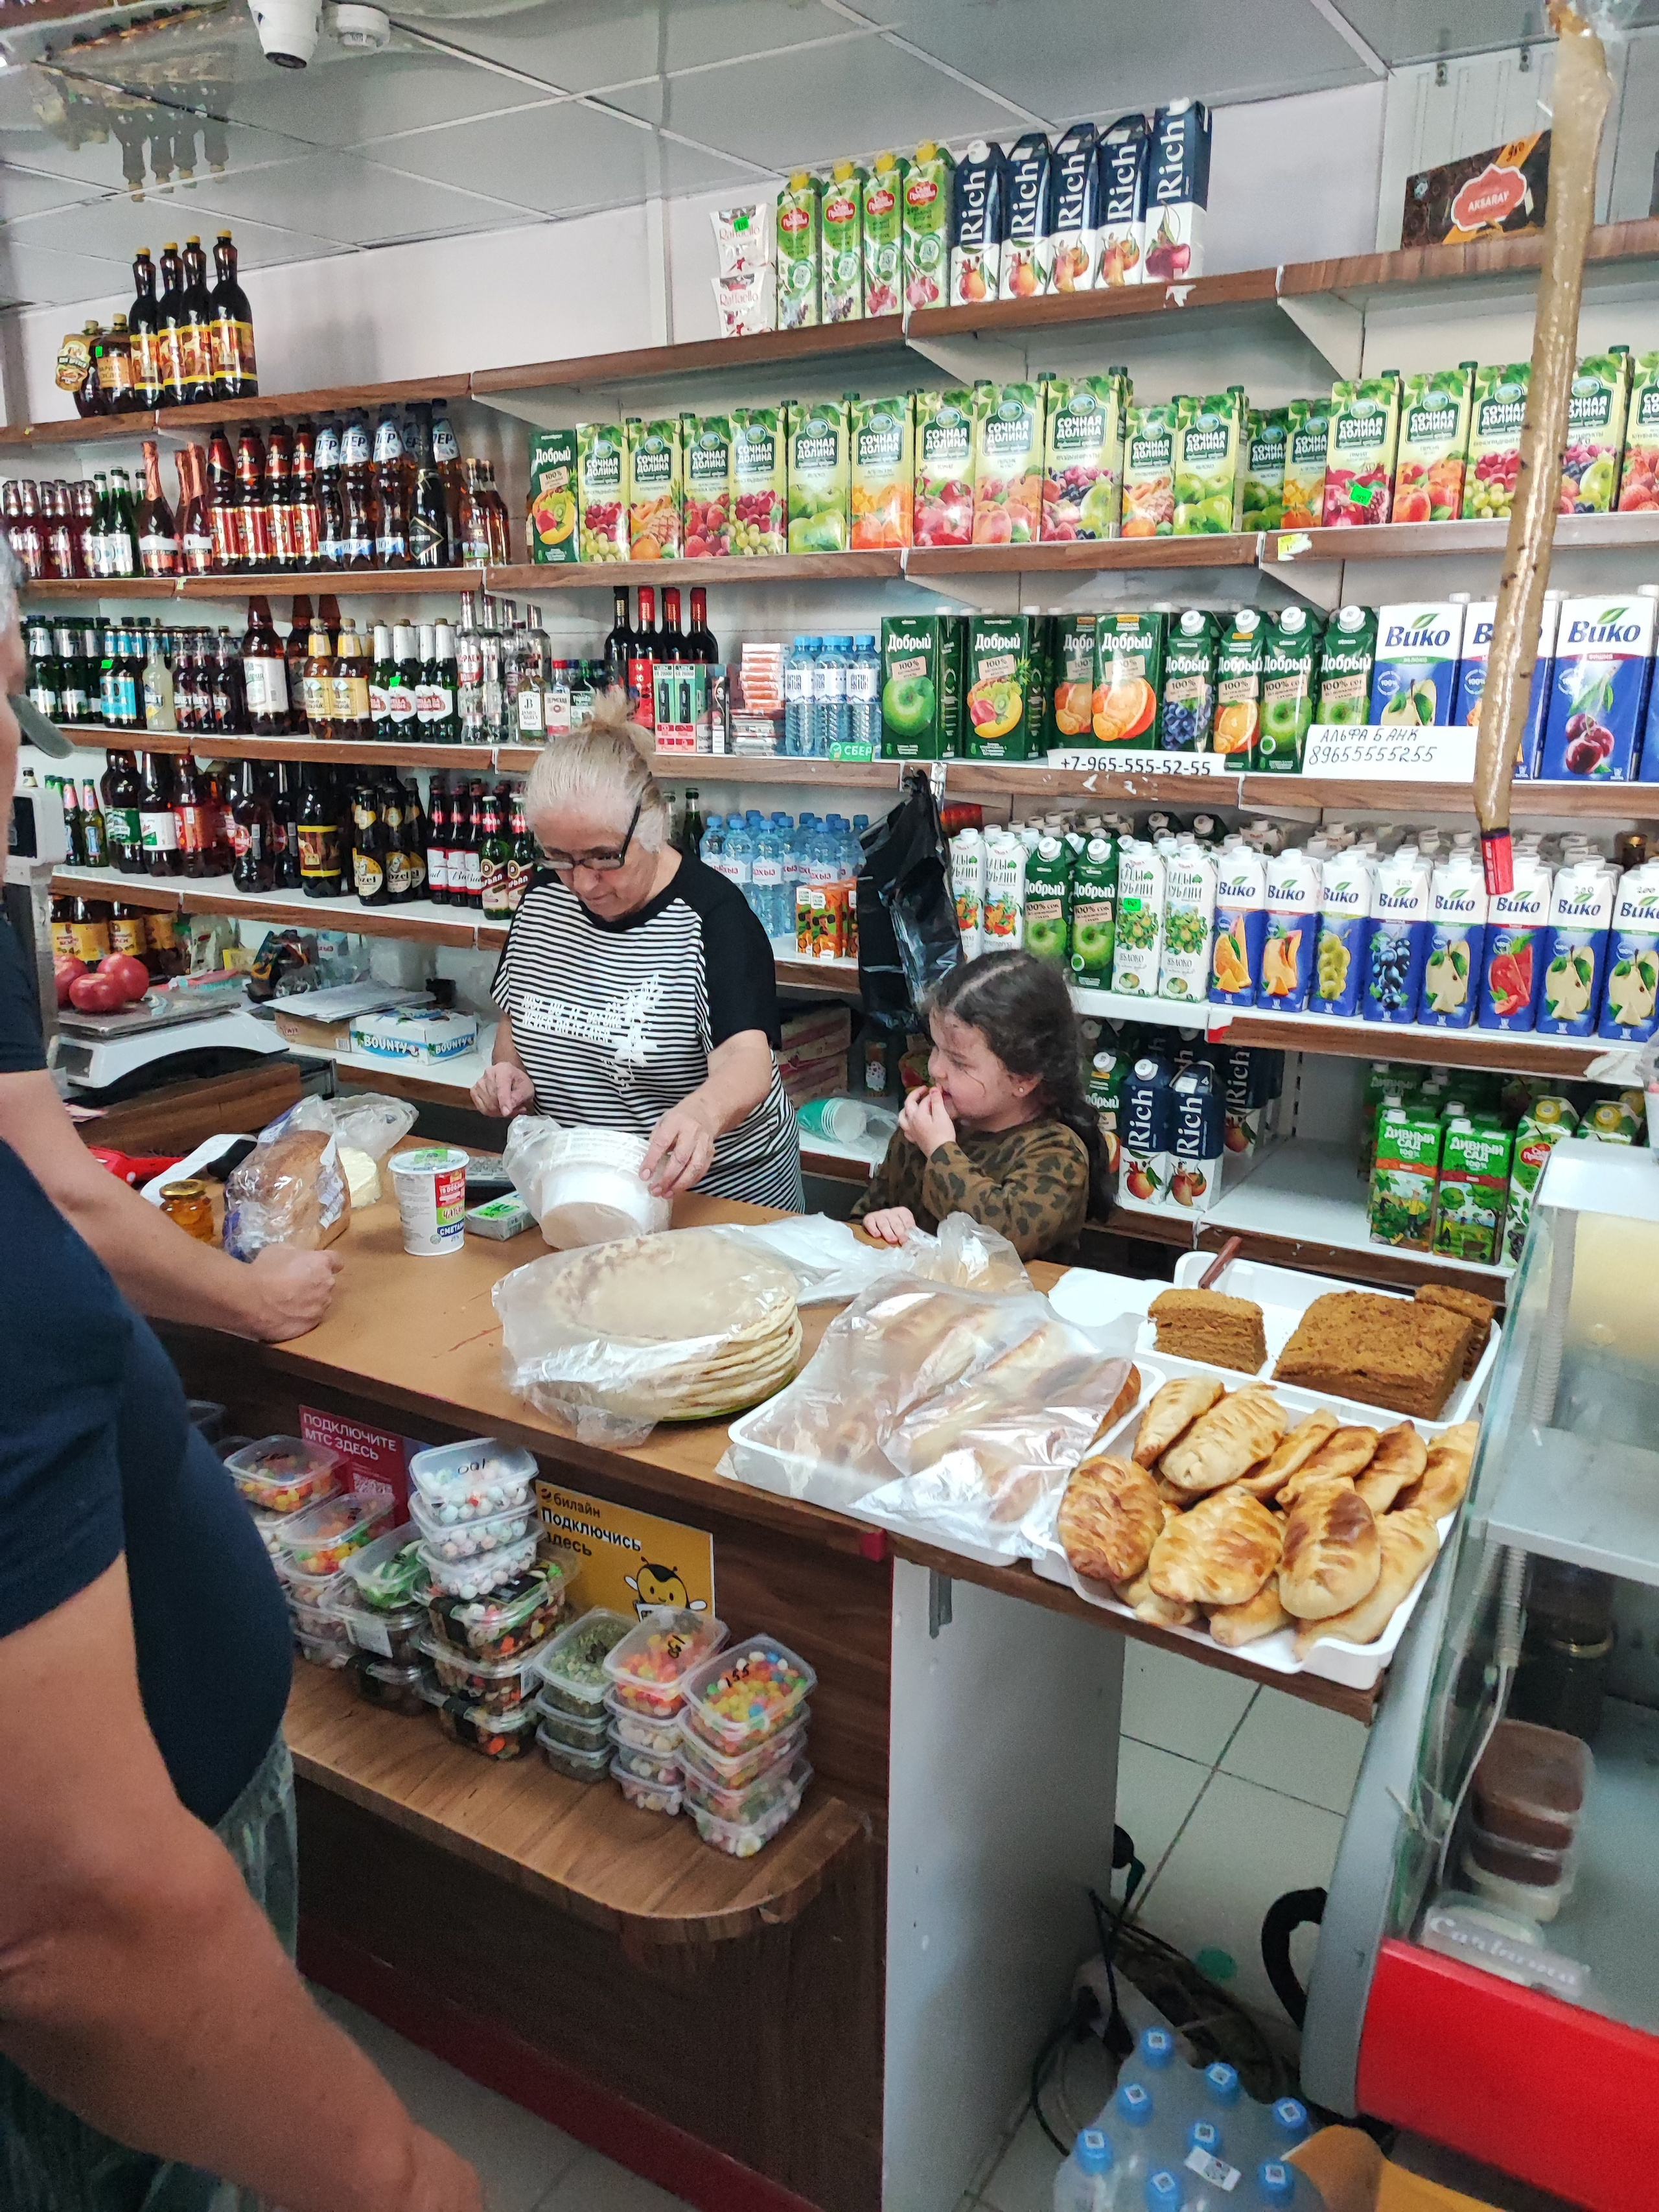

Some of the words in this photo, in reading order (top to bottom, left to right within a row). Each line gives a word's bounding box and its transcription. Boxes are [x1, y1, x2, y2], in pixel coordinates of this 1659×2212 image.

[1157, 119, 1185, 200] Rich
[1107, 143, 1136, 221] Rich
[1057, 152, 1086, 229] Rich
[962, 169, 986, 242] Rich
[1012, 160, 1038, 240] Rich
[719, 291, 758, 306] Raffaello
[1057, 415, 1102, 427] СОЧНАЯ
[1340, 417, 1383, 430] СОЧНАЯ
[1411, 410, 1455, 423] СОЧНАЯ
[926, 428, 967, 439] СОЧНАЯ
[988, 421, 1029, 432] СОЧНАЯ
[1057, 426, 1102, 439] ДОЛИНА
[1339, 427, 1382, 440] ДОЛИНА
[1410, 420, 1453, 434] ДОЛИНА
[797, 437, 835, 449] СОЧНАЯ
[860, 432, 899, 445] СОЧНАЯ
[925, 438, 967, 450] ДОЛИНА
[987, 431, 1028, 444] ДОЛИНА
[1133, 439, 1169, 450] СОЧНАЯ
[1186, 431, 1225, 443] СОЧНАЯ
[1295, 435, 1327, 445] СОЧНА
[737, 443, 772, 453] СОЧНАЯ
[797, 448, 835, 460] ДОЛИНА
[860, 443, 899, 455] ДОЛИНА
[1132, 448, 1168, 460] ДОЛИНА
[1186, 440, 1225, 453] ДОЛИНА
[1295, 443, 1327, 454] ДОЛИН
[535, 446, 571, 465] Добрый
[586, 458, 618, 467] СОЧНАЯ
[637, 453, 669, 464] СОЧНАЯ
[692, 450, 726, 460] СОЧНАЯ
[737, 452, 772, 464] ДОЛИНА
[586, 466, 618, 478] ДОЛИНА
[636, 463, 669, 474] ДОЛИНА
[692, 459, 726, 470] ДОЛИНА
[1385, 626, 1451, 647] Вико
[1567, 621, 1641, 643] Вико
[888, 633, 932, 652] Добрый
[975, 633, 1021, 652] Добрый
[1063, 633, 1095, 652] Добр
[1102, 632, 1154, 652] Добрый
[1165, 655, 1210, 674] Добрый
[1218, 655, 1263, 675] Добрый
[1263, 654, 1312, 673] Добрый
[1321, 653, 1372, 673] Добрый
[1172, 679, 1196, 690] 100%
[1224, 681, 1248, 691] 100%
[1266, 681, 1290, 692] 100%
[1323, 680, 1348, 692] 100%
[1320, 728, 1368, 743] АЛЬФА
[844, 745, 872, 756] СБЕР
[1308, 745, 1437, 765] 89655555255
[1061, 756, 1211, 776] +7-965-555-52-55
[1074, 881, 1115, 900] Добрый
[1218, 881, 1256, 898] Вико
[1268, 885, 1305, 901] Вико
[1323, 887, 1359, 903] Вико
[1379, 893, 1419, 909] Вико
[1435, 895, 1475, 912] Вико
[1496, 898, 1540, 913] Вико
[1558, 899, 1601, 916] Вико
[364, 1035, 408, 1054] BOUNTY
[435, 1038, 467, 1054] BOUNTY
[1225, 1051, 1250, 1108] Rich
[1128, 1089, 1154, 1149] Rich
[1176, 1097, 1203, 1157] Rich
[303, 1413, 397, 1452] ПОДКЛЮЧИТЕ
[305, 1428, 332, 1446] МТС
[335, 1437, 379, 1460] ЗДЕСЬ
[553, 1493, 601, 1519] билайн
[541, 1508, 642, 1552] Подключись
